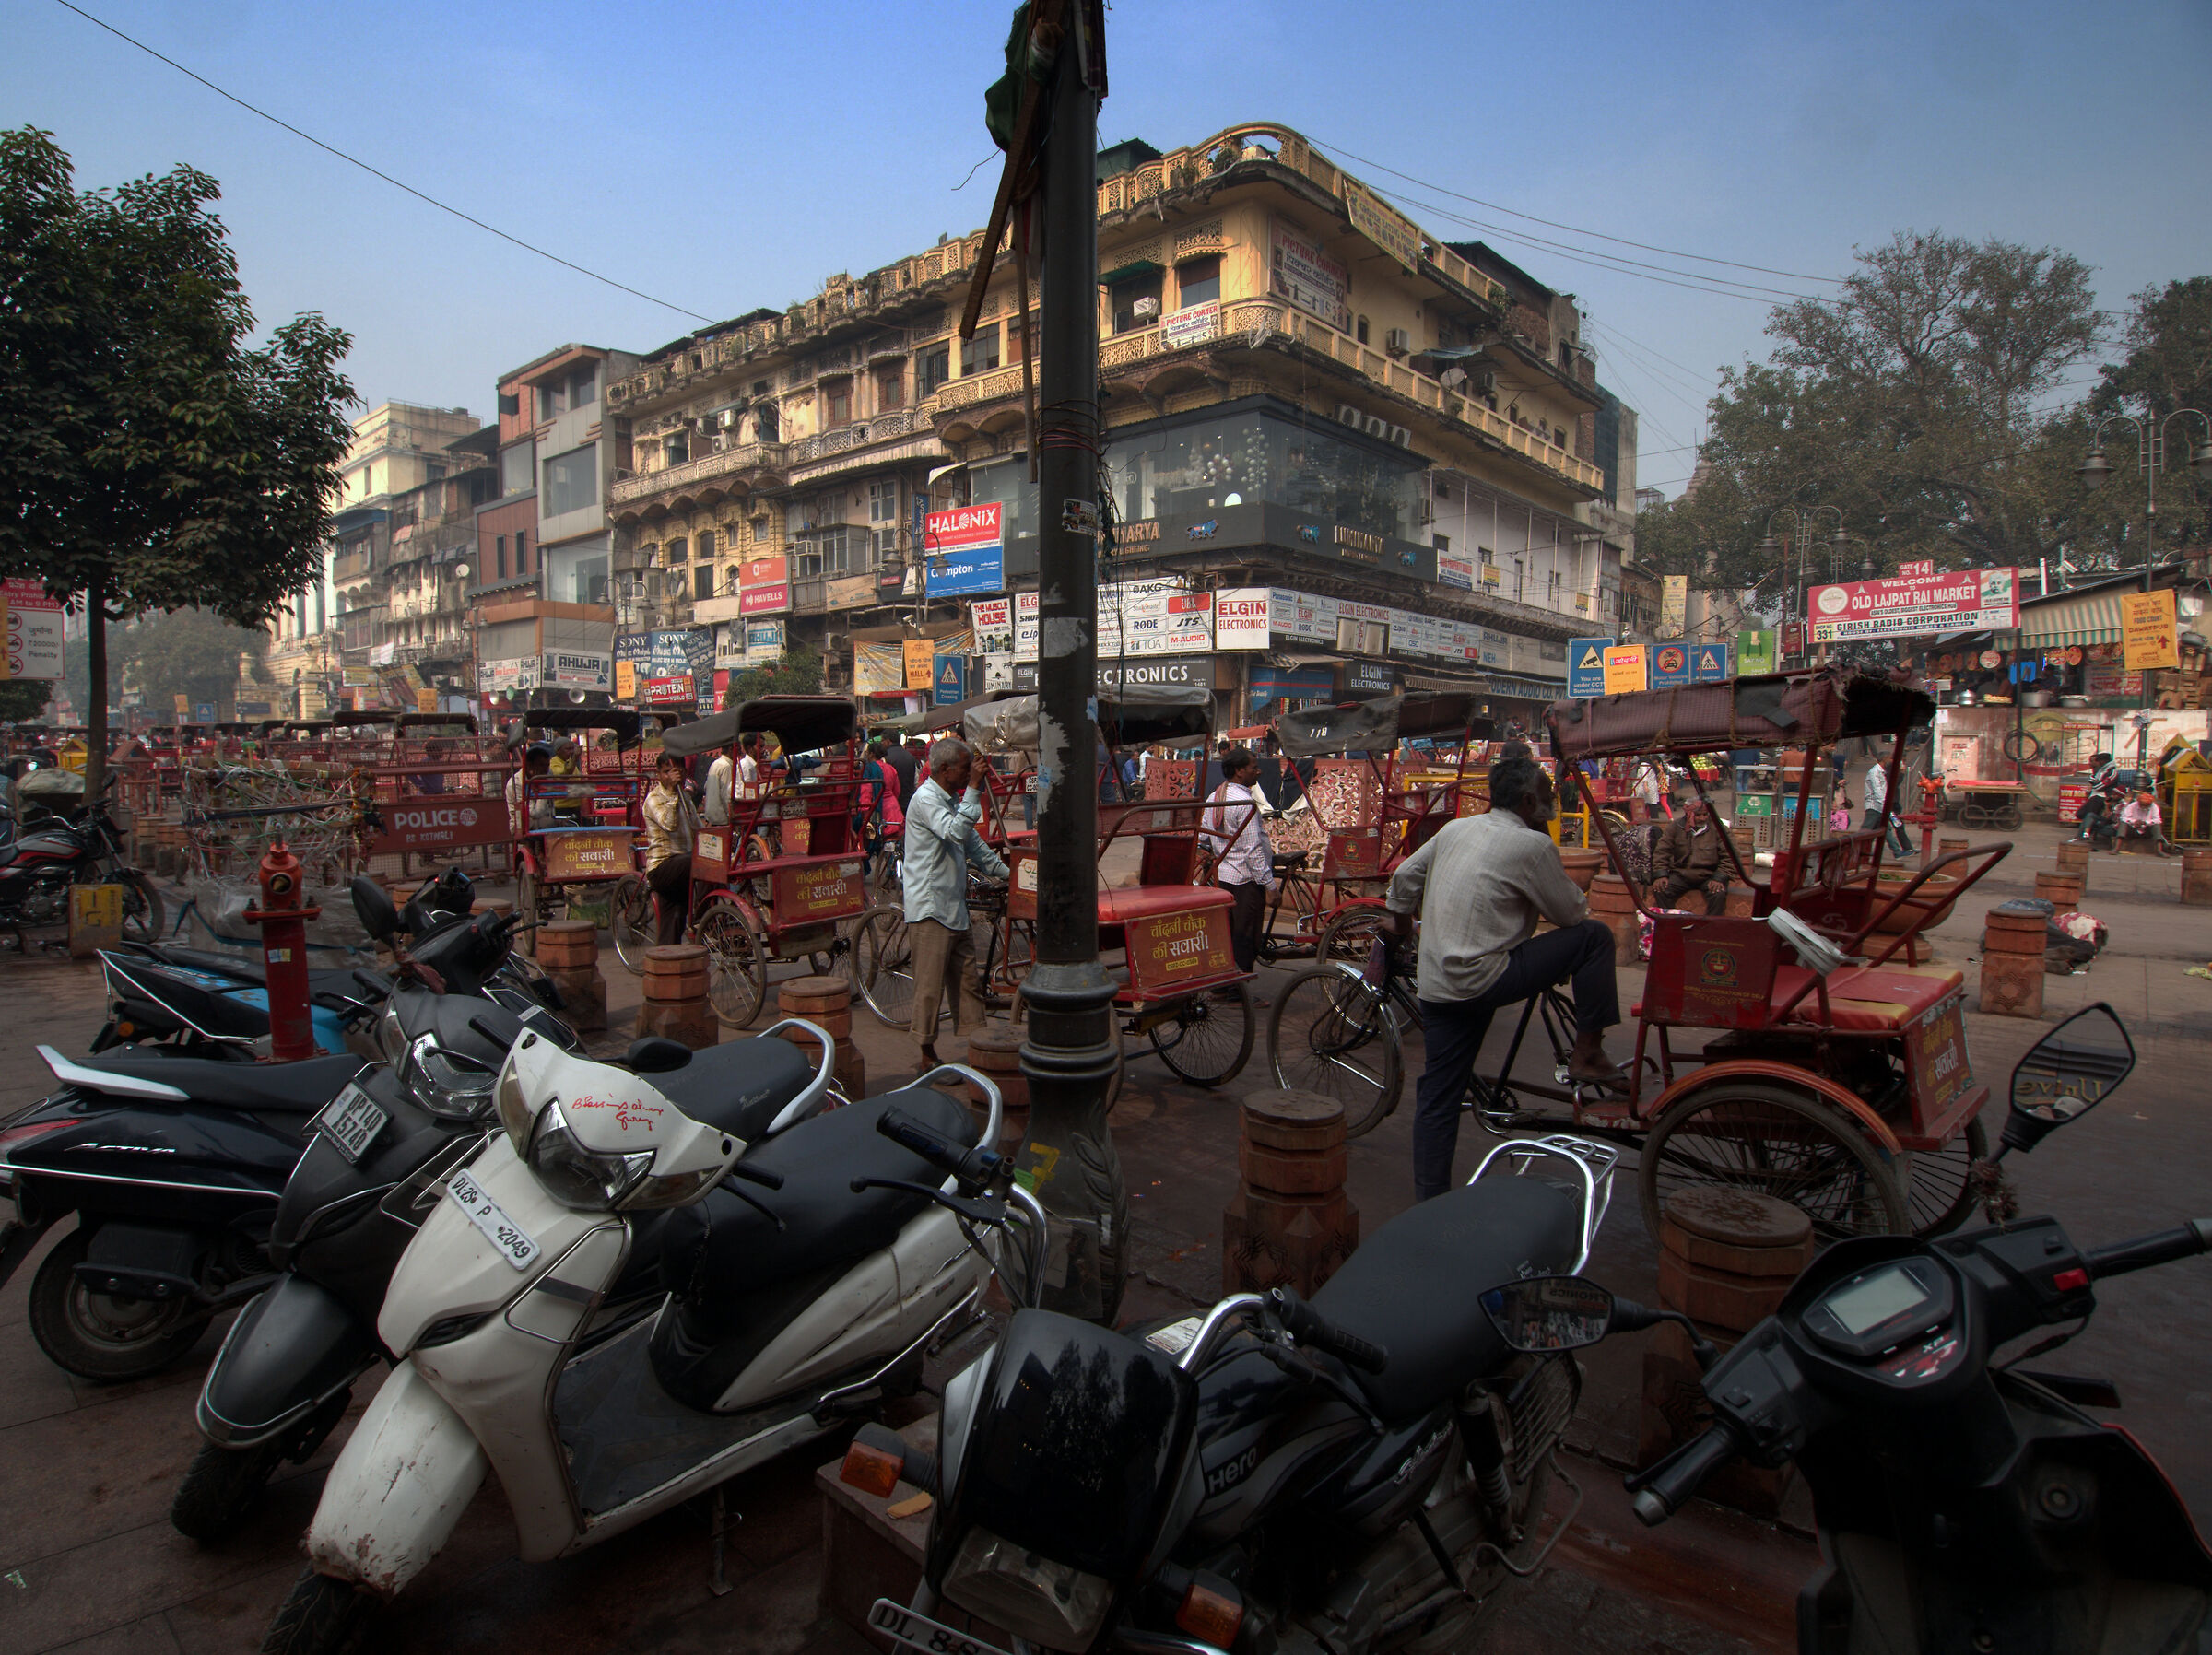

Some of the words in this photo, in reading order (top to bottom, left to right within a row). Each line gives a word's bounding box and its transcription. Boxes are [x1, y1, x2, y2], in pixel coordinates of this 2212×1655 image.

[1282, 234, 1316, 266] PICTURE
[1316, 256, 1347, 280] CORNER
[1167, 312, 1192, 326] PICTURE
[1193, 306, 1218, 319] CORNER
[929, 509, 996, 533] HALONIX
[931, 563, 973, 579] Cmpton
[1913, 562, 1930, 576] 14
[1141, 583, 1163, 594] AKG
[1881, 576, 1945, 589] WELCOME
[754, 592, 782, 604] HAVELLS
[1272, 591, 1293, 603] Panasonic
[1852, 594, 1872, 610] OLD
[1874, 590, 1912, 608] LAJPAT
[1914, 589, 1931, 604] RAI
[1933, 585, 1977, 603] MARKET
[974, 604, 987, 615] THE
[987, 601, 1008, 613] MUSCLE
[1218, 602, 1267, 617] ELGIN
[1298, 608, 1314, 619] ELGIN
[1338, 602, 1355, 616] ELGIN
[1356, 605, 1390, 621] ELECTRONICS
[977, 610, 1006, 627] HOUSE
[1177, 618, 1200, 628] JTS
[1218, 619, 1267, 630] ELECTRONICS
[1837, 620, 1870, 632] GIRISH
[1874, 617, 1902, 628] RADIO
[1906, 612, 1979, 626] CORPORATION
[1817, 630, 1832, 640] 331
[2128, 624, 2169, 633] DAWATPUR
[1143, 640, 1162, 650] TOA
[1171, 634, 1206, 644] M-AUDIO
[1482, 631, 1508, 645] AHUJA
[29, 651, 58, 659] Penalty
[559, 654, 600, 670] AHUJA
[1361, 663, 1382, 679] ELGIN
[650, 682, 684, 698] PROTEIN
[1350, 680, 1390, 692] ELECTRONICS
[1518, 682, 1540, 699] AUDIO
[1541, 685, 1554, 699] CO.
[394, 809, 459, 830] POLICE
[420, 831, 453, 841] KOTWALI
[580, 848, 615, 862] सवारी!
[811, 879, 848, 899] सवारी!
[1182, 913, 1206, 932] चौक
[1151, 941, 1168, 959] की
[1169, 930, 1210, 957] सवारी!
[347, 1091, 383, 1133] UP14D
[476, 1204, 493, 1217] P
[497, 1227, 532, 1260] 2049
[1207, 1447, 1258, 1496] Hero
[876, 1605, 915, 1642] DL
